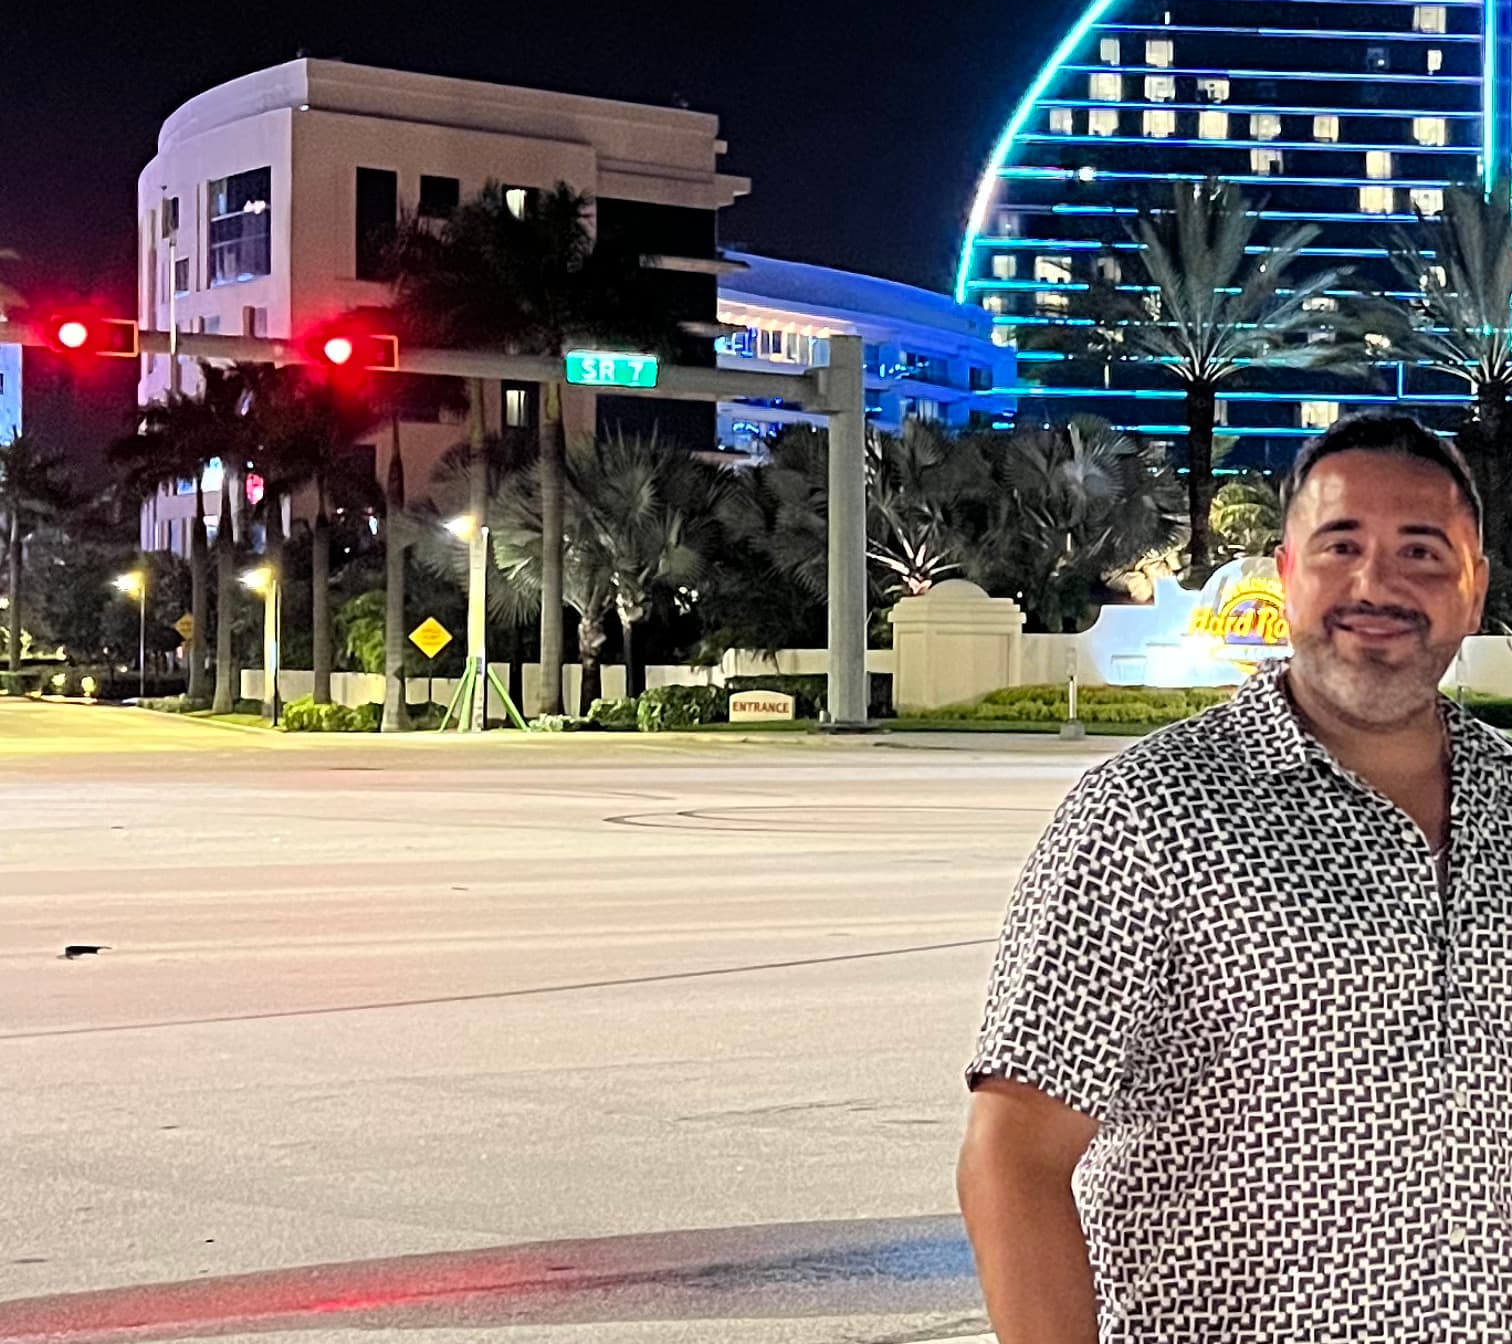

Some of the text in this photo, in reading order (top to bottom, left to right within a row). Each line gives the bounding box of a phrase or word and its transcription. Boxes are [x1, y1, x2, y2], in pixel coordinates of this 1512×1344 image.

[581, 358, 644, 382] SR 7
[1189, 606, 1290, 644] Hard Ro
[732, 701, 790, 714] ENTRANCE
